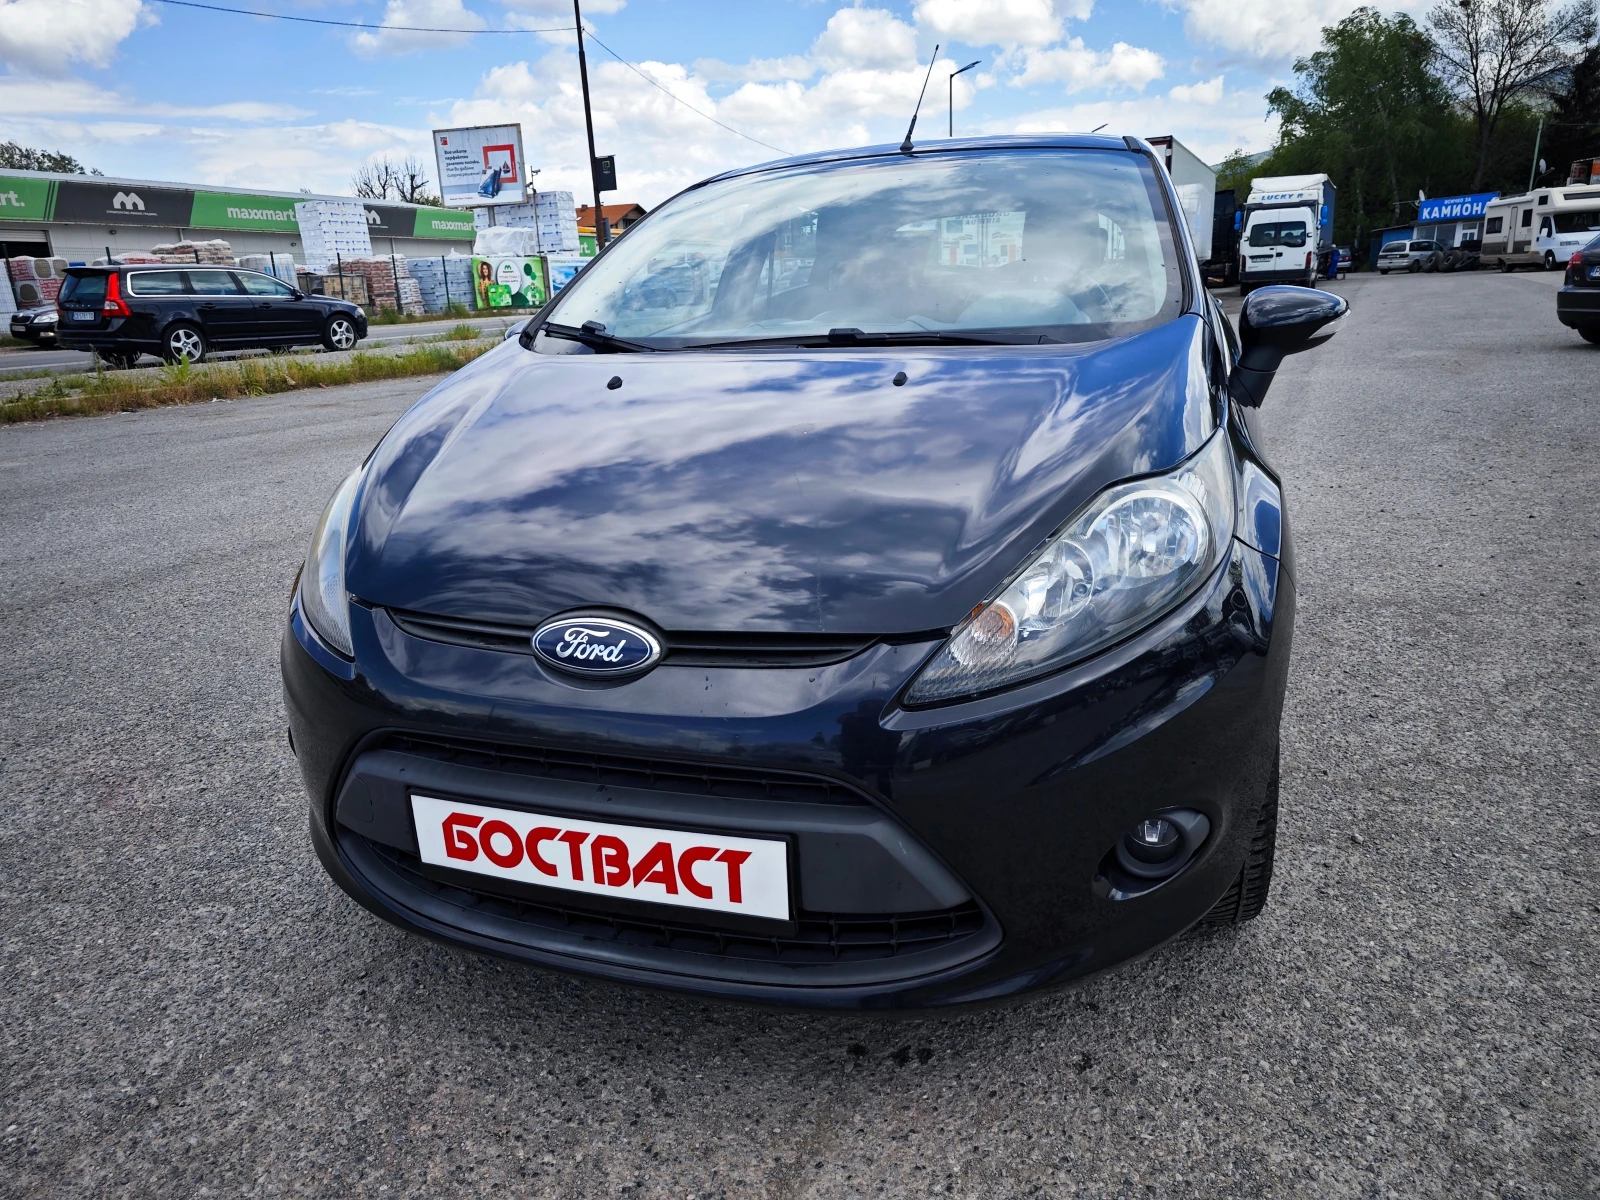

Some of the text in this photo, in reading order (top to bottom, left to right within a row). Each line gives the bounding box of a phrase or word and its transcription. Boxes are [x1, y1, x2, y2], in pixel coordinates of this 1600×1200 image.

[965, 217, 1001, 225] AUSTRIA
[555, 627, 627, 663] Ford
[441, 811, 752, 903] БОСТВАСТ
